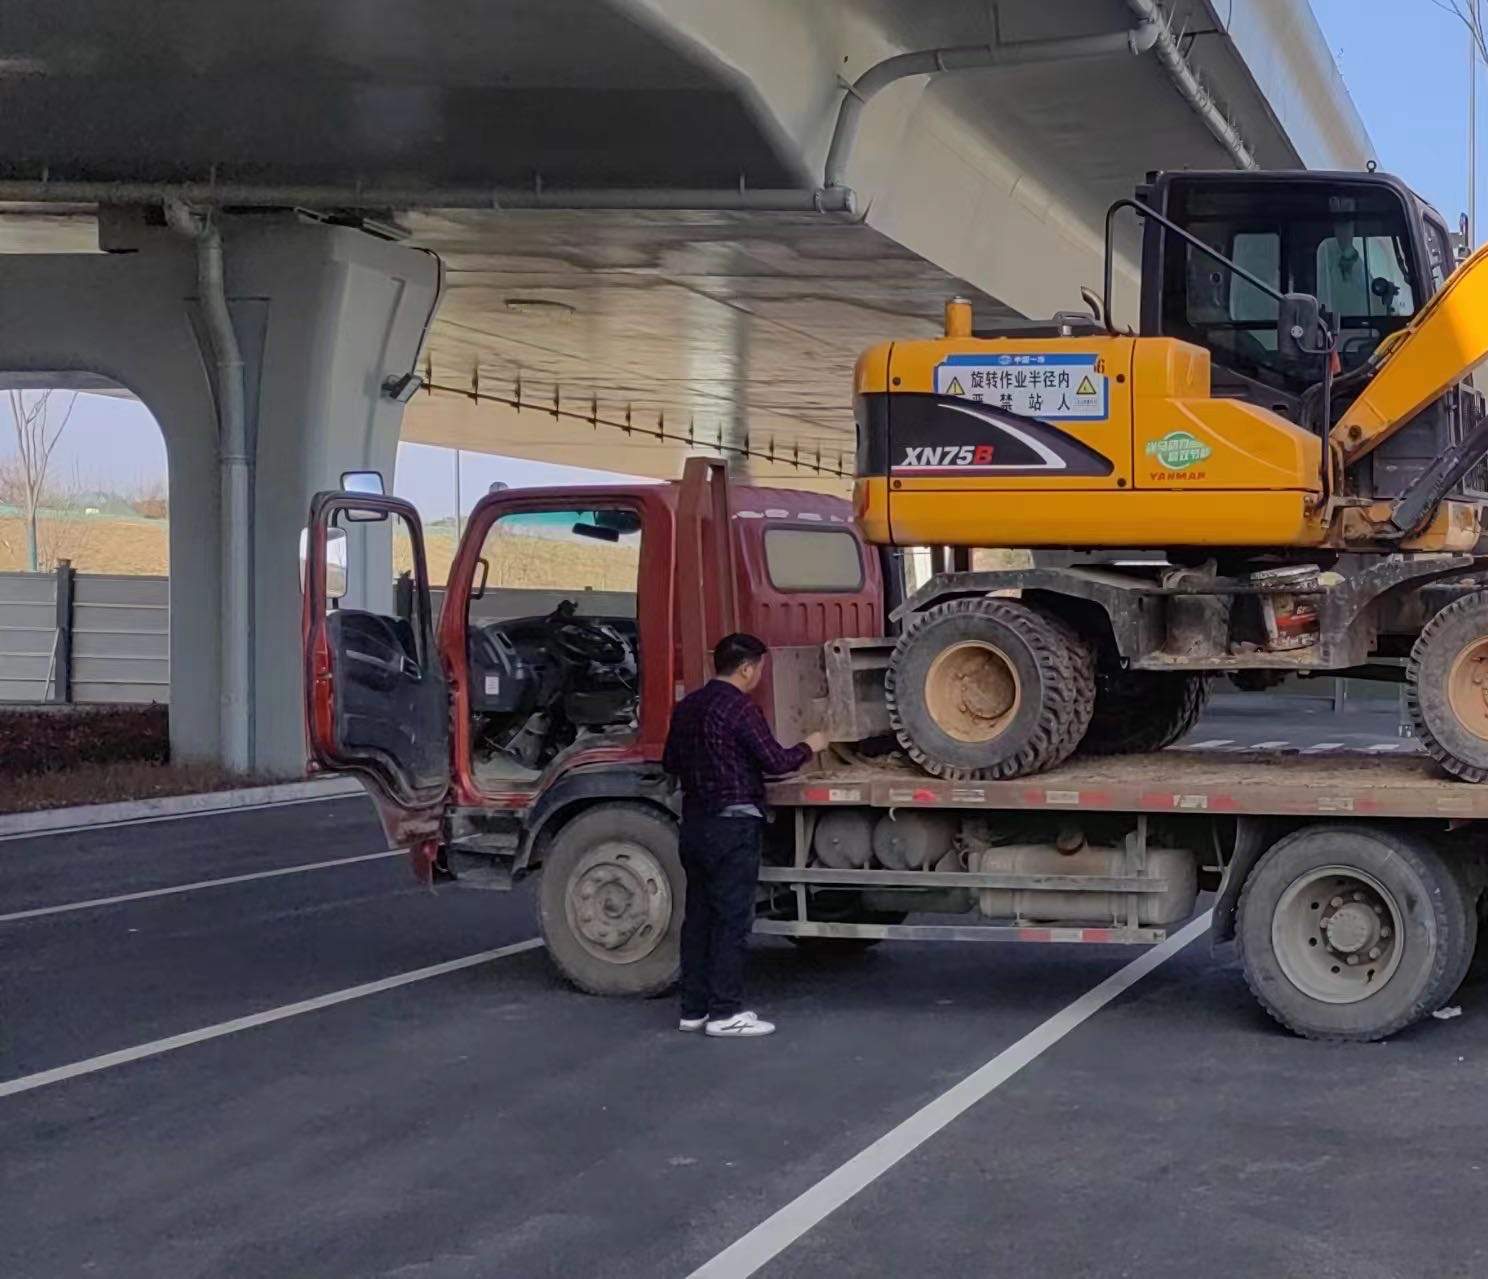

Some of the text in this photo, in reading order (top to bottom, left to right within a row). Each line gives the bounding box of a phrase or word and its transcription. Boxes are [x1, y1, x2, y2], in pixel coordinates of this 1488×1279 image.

[971, 369, 1070, 390] 旋转作业半径内
[900, 445, 994, 466] XN75B
